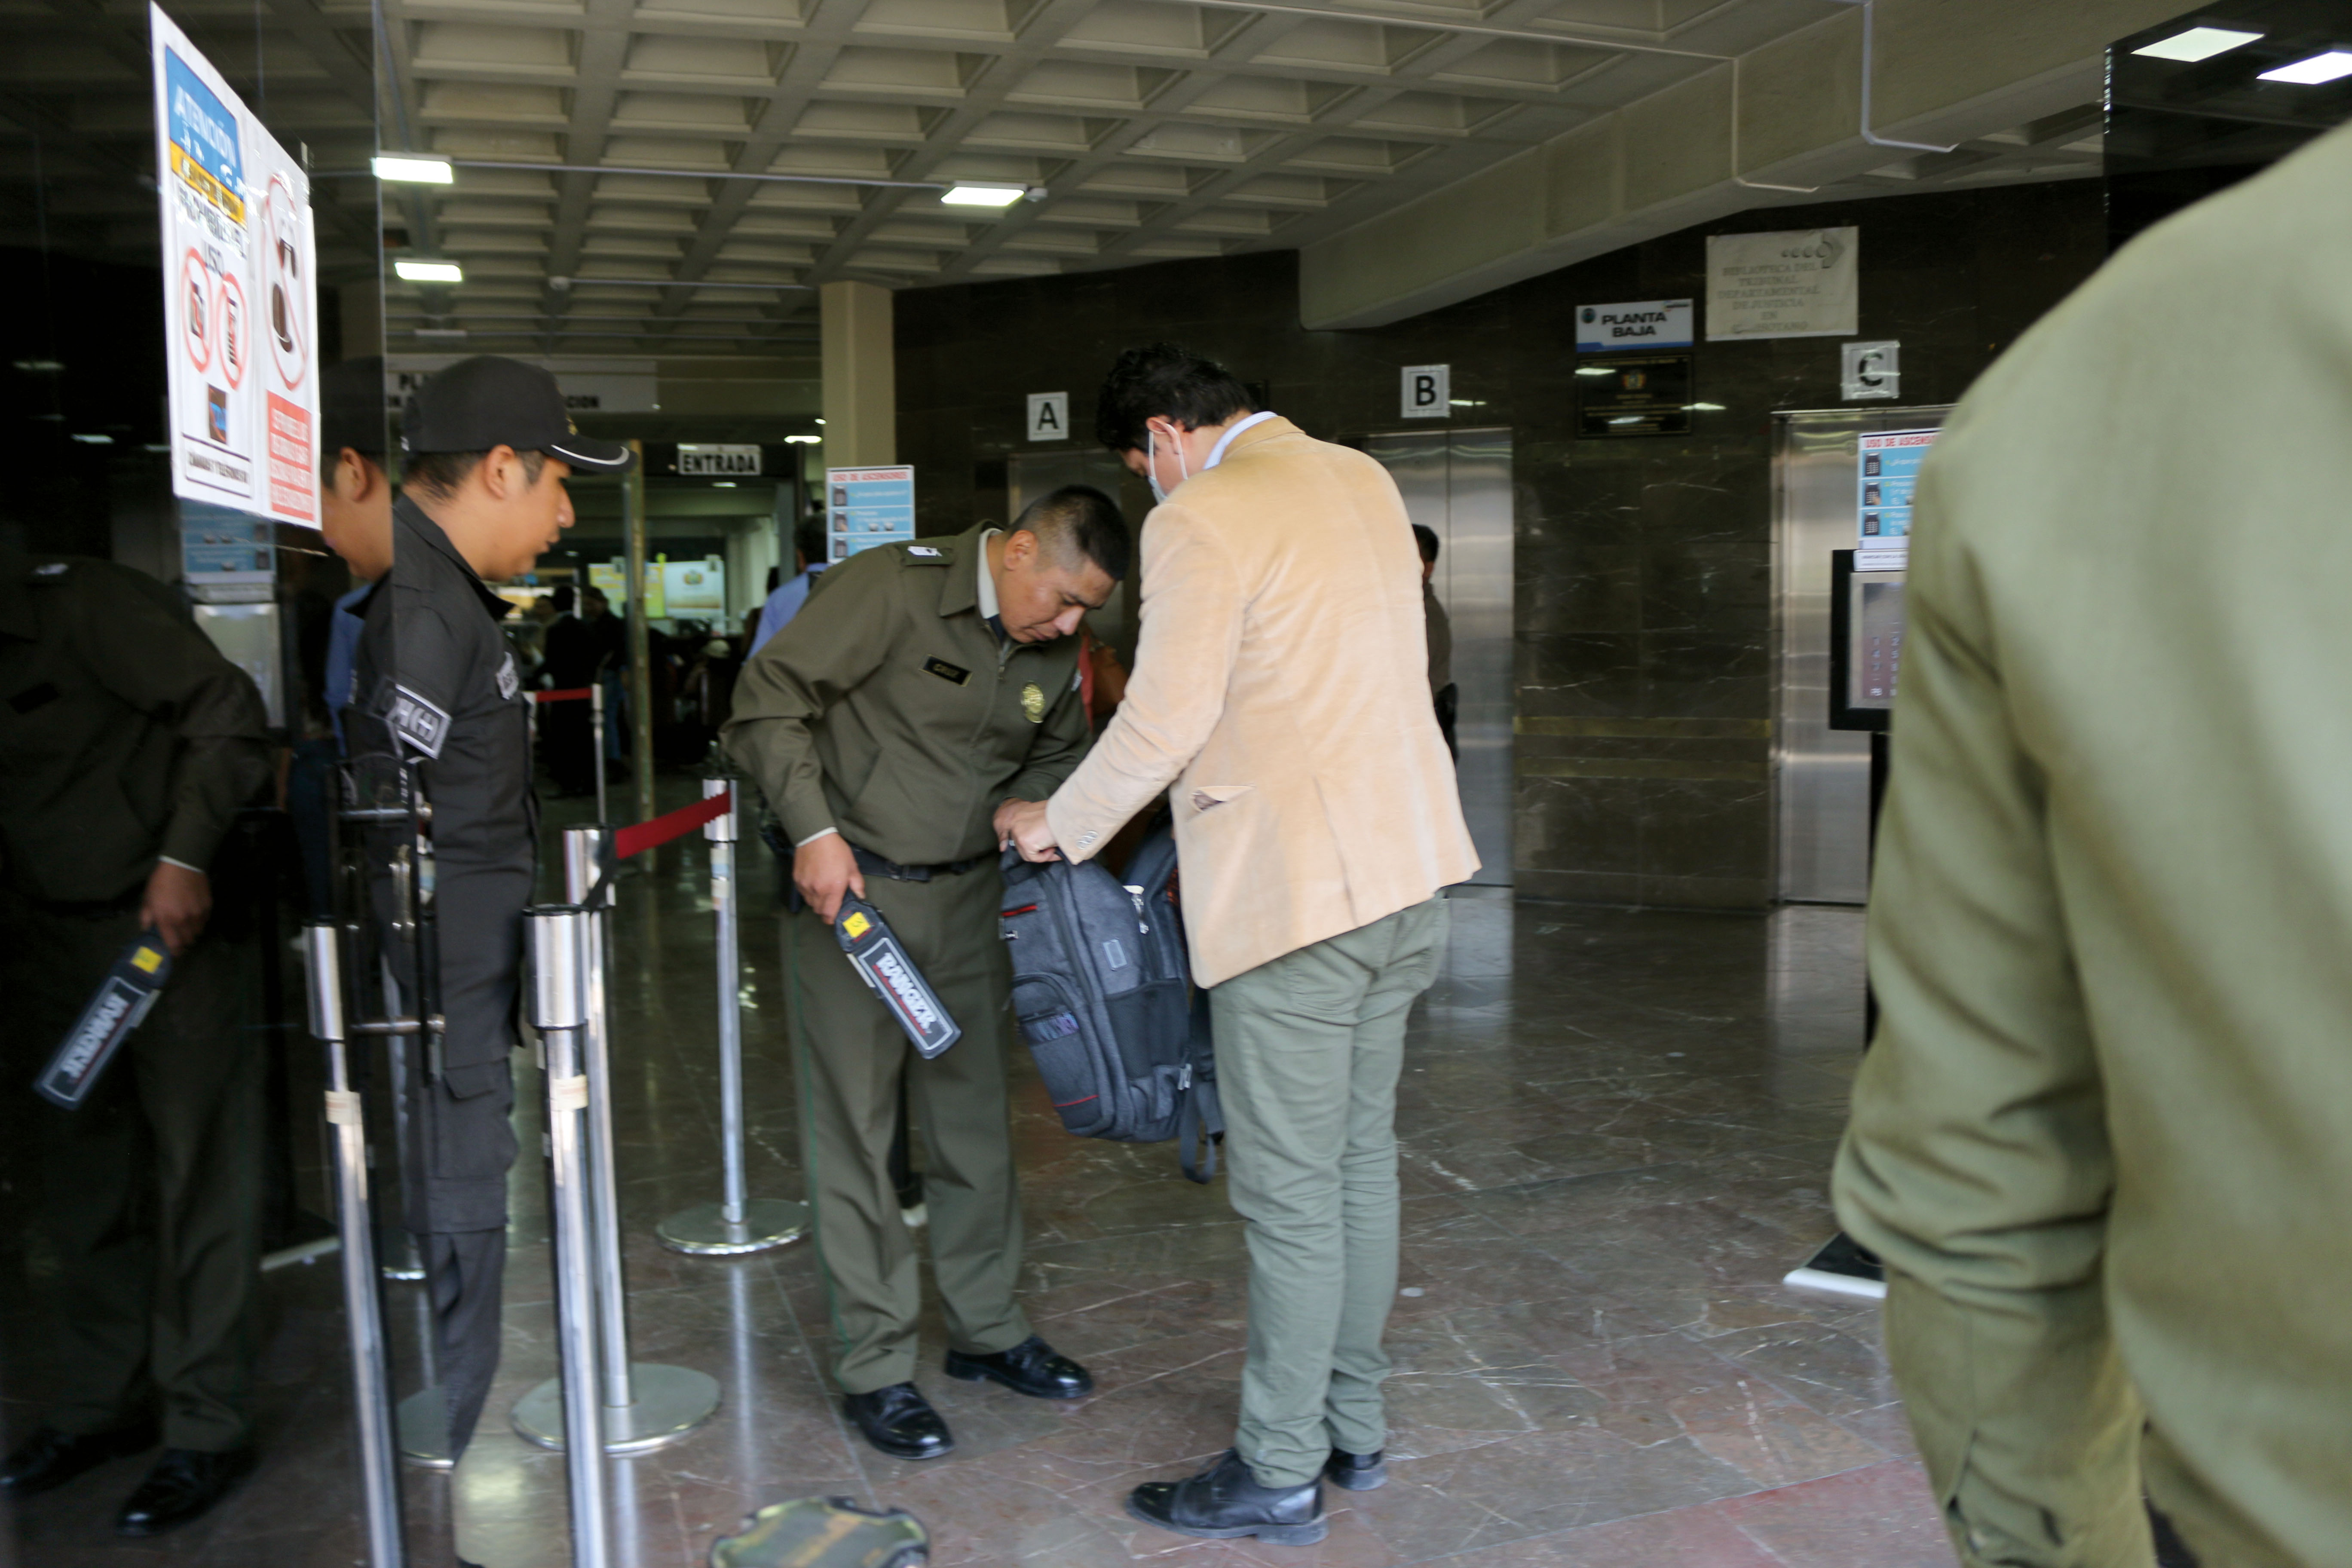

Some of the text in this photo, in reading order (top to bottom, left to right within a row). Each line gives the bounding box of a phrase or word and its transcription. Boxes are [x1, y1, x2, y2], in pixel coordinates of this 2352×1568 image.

[174, 84, 237, 168] ATENCIÓN
[1602, 312, 1667, 325] PLANTA
[1613, 325, 1656, 338] BAJA
[1858, 352, 1883, 386] C
[1416, 375, 1436, 406] B
[1037, 401, 1059, 430] A
[1865, 439, 1881, 448] USO
[1885, 438, 1896, 447] DE
[684, 454, 756, 472] ENTRADA
[876, 952, 937, 1030] RANGER
